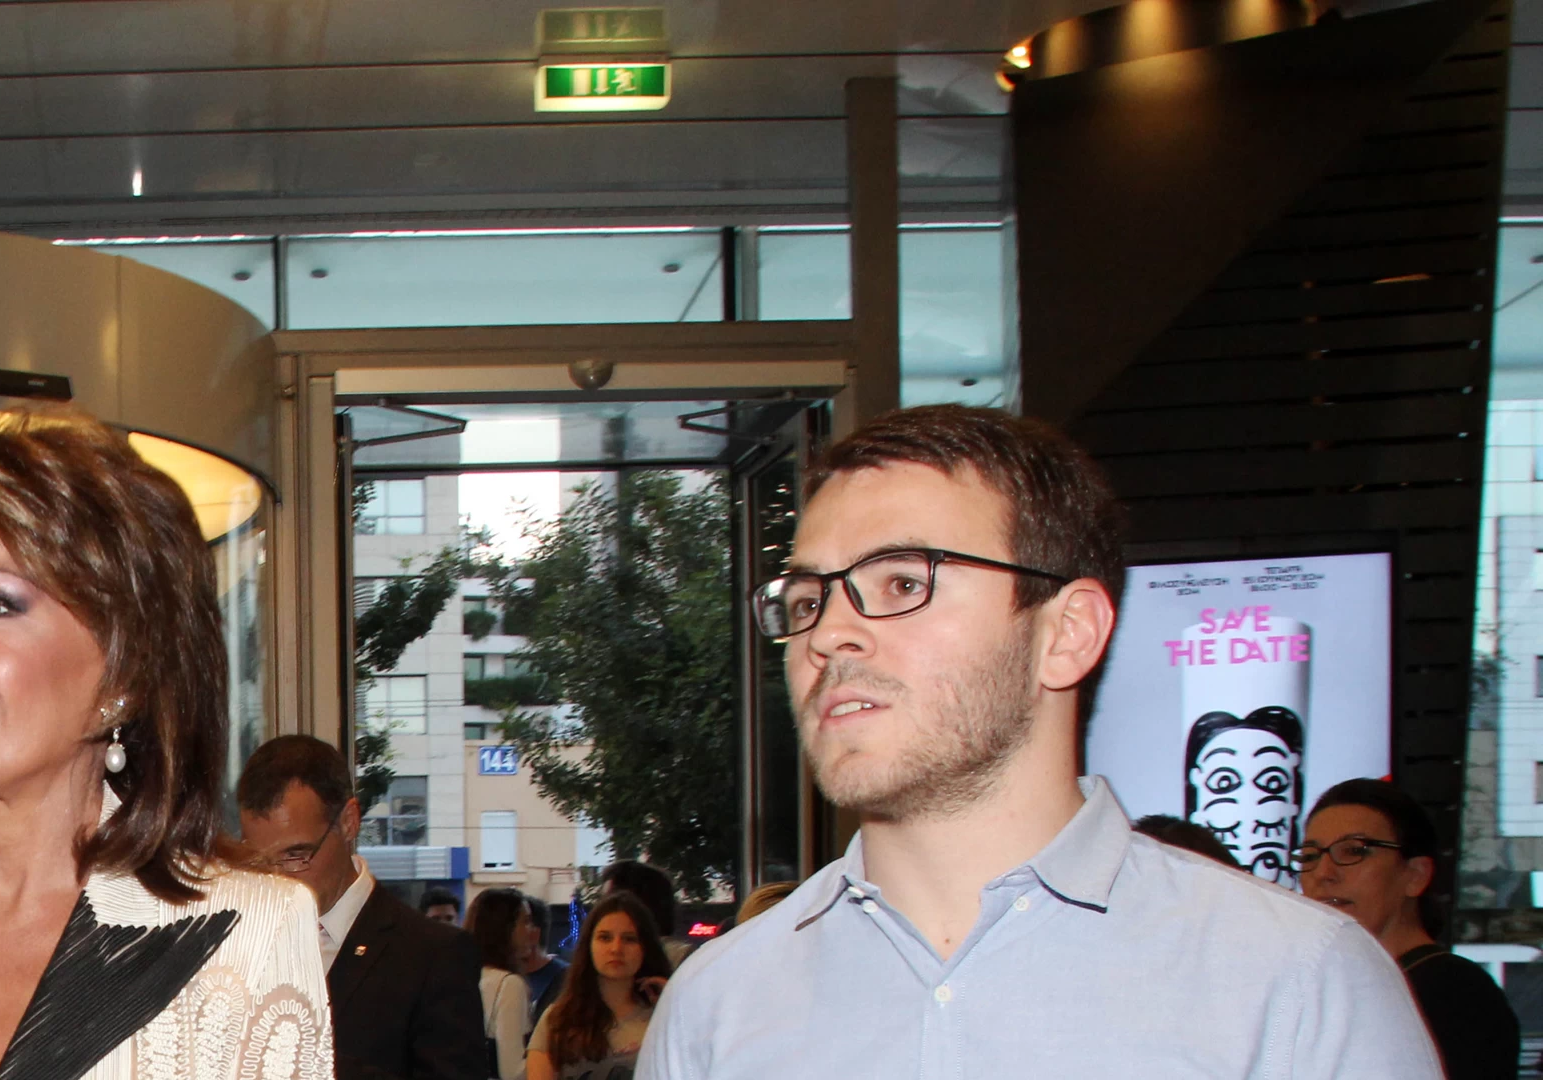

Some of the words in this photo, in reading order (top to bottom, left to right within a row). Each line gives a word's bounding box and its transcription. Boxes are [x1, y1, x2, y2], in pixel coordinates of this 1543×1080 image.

[1199, 605, 1272, 634] SAVE
[1163, 640, 1217, 666] THE
[1229, 634, 1310, 664] DATE
[480, 750, 515, 771] 144
